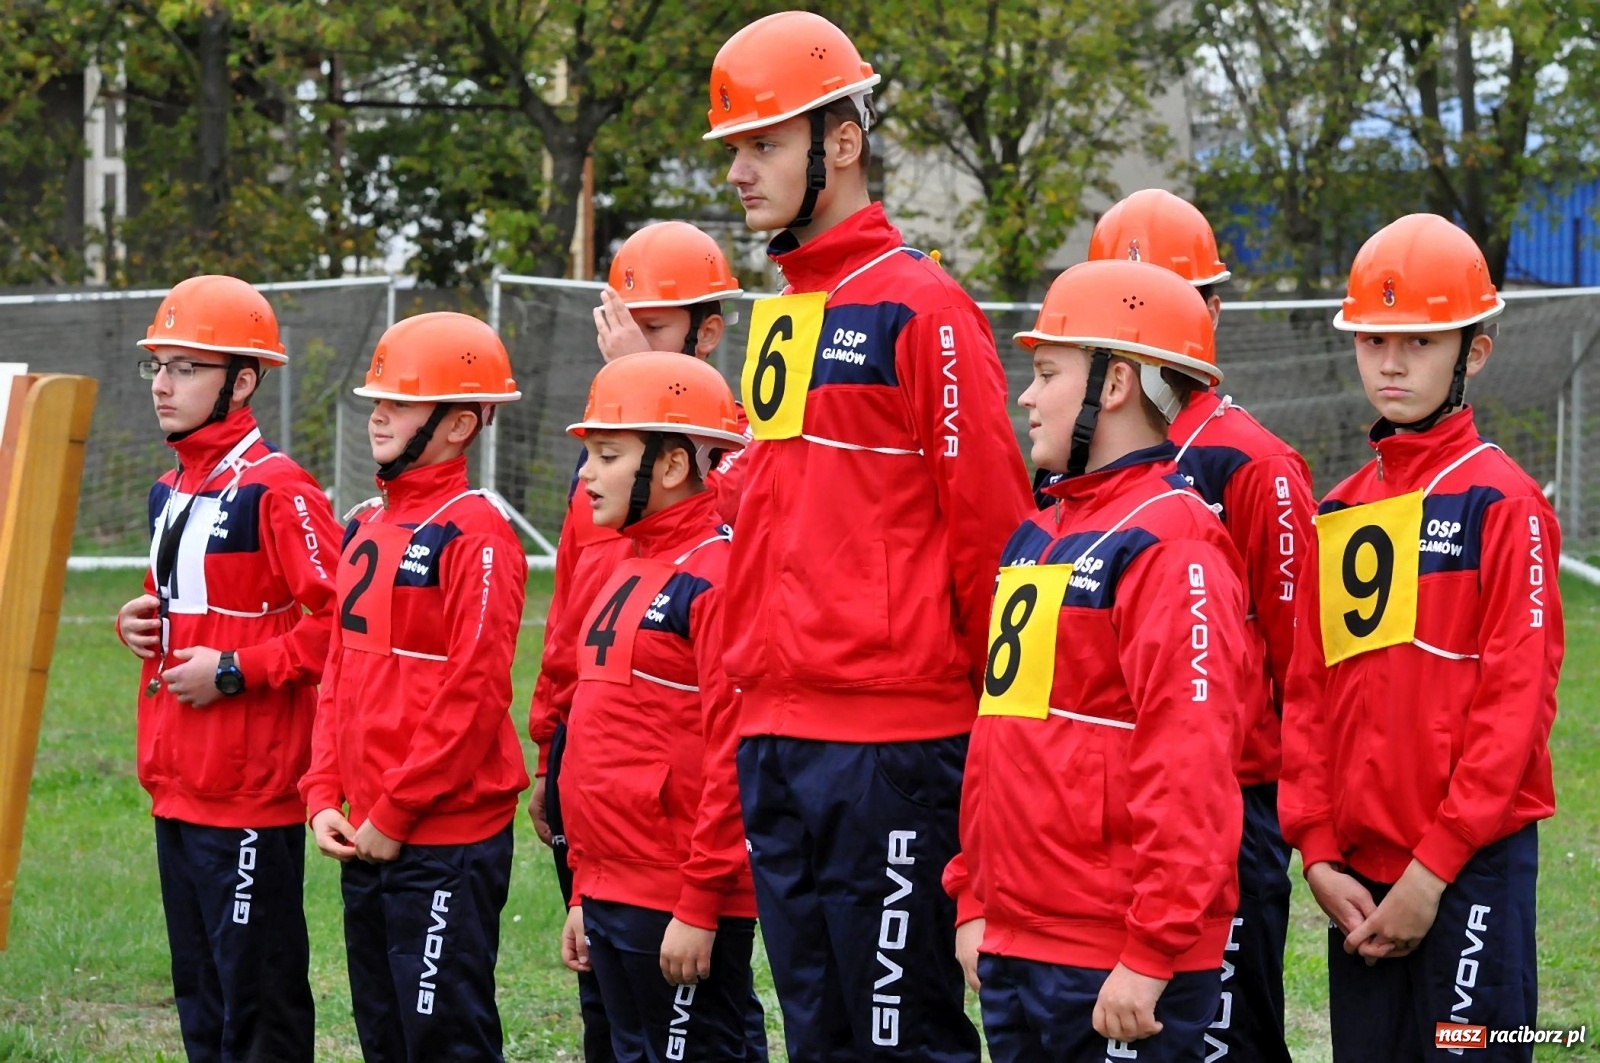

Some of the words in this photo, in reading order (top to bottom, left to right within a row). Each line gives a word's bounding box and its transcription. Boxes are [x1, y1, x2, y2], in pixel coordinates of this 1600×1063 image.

[752, 315, 793, 421] 6
[822, 348, 866, 366] GAMÓW
[833, 328, 867, 348] OSP
[939, 325, 959, 458] GIVOVA
[1073, 556, 1104, 574] OSP
[1274, 476, 1294, 602] GIVOVA
[1342, 524, 1394, 638] 9
[1418, 538, 1463, 557] GAMÓW
[1427, 519, 1461, 538] OSP
[1528, 515, 1543, 628] GIVOVA
[341, 539, 379, 635] 2
[585, 575, 641, 667] 4
[985, 583, 1037, 697] 8
[1187, 563, 1208, 702] GIVOVA
[233, 828, 258, 925] GIVOV
[417, 889, 452, 1015] GIVOVA
[872, 830, 916, 1046] GIVOVA
[1448, 904, 1491, 1055] IVOVA
[666, 983, 697, 1061] GIVO
